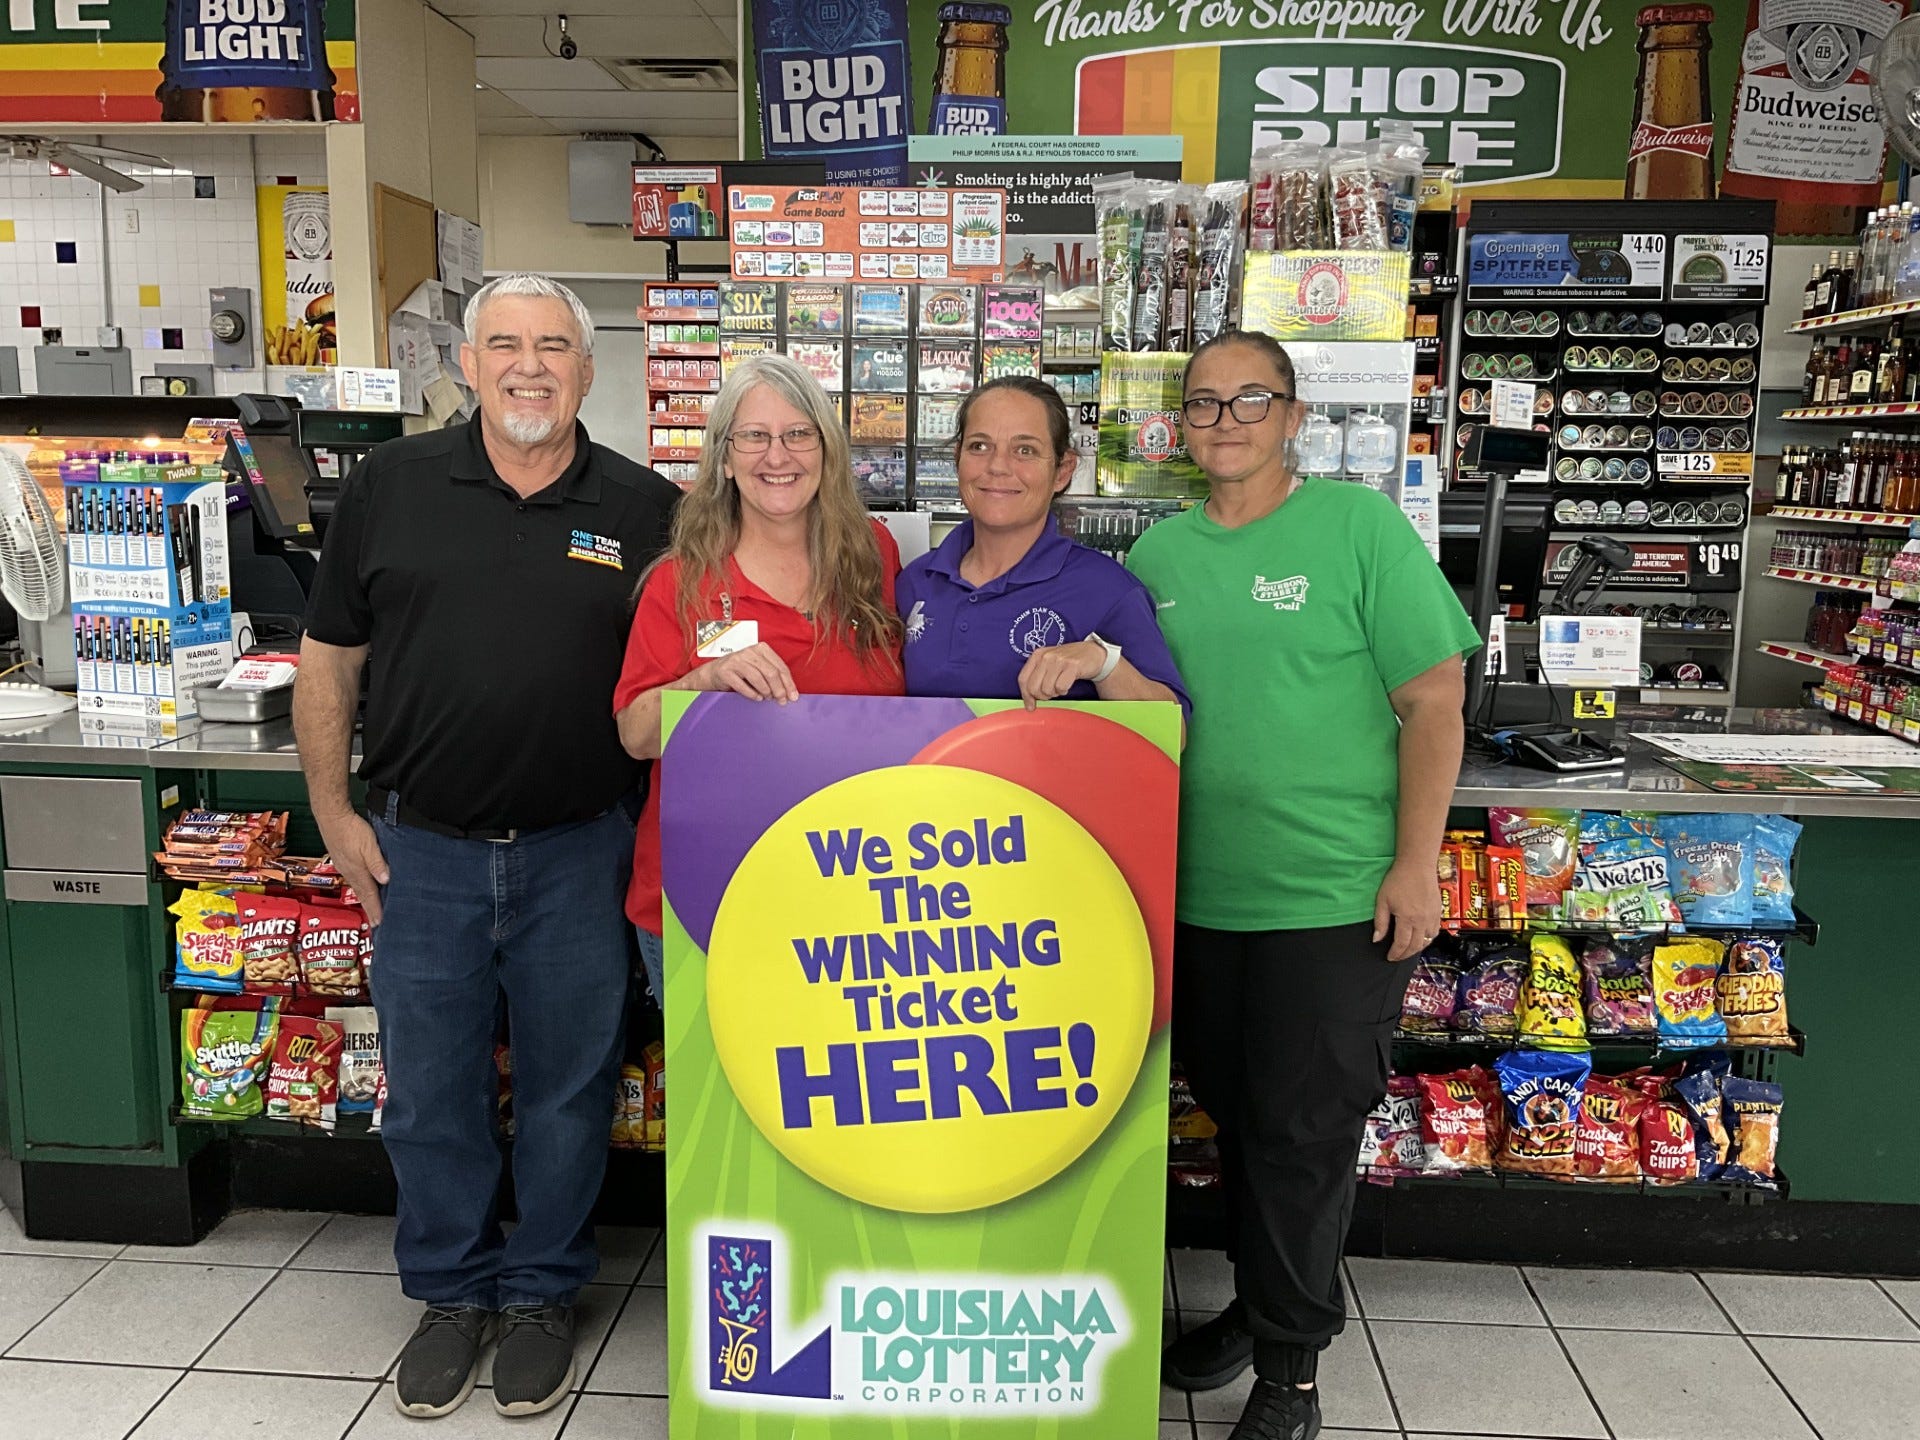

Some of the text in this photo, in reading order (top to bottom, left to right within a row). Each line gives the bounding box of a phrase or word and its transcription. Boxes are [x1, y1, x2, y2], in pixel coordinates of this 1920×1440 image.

[199, 0, 287, 25] BUD
[1034, 0, 1612, 50] Thanks For Shopping With Us
[184, 27, 302, 61] LIGHT
[781, 55, 887, 101] BUD
[1254, 66, 1526, 113] SHOP
[769, 95, 902, 144] LIGHT
[946, 107, 990, 126] BUD
[1632, 129, 1712, 150] Budweiser
[834, 168, 871, 179] USING THE
[955, 173, 1070, 188] Smoking is highly
[798, 190, 818, 201] Fast
[1014, 192, 1048, 205] is the
[784, 208, 845, 217] Game Board
[921, 232, 946, 243] Clue
[1484, 239, 1560, 259] Copenhagen
[1473, 260, 1572, 271] SPITFREE
[898, 287, 903, 295] 3
[966, 289, 971, 297] 2
[733, 292, 764, 314] SIX
[928, 301, 967, 313] CASINO
[724, 315, 773, 330] FIGURES
[764, 341, 773, 349] 10
[832, 343, 838, 351] 9
[873, 351, 903, 363] Clue
[922, 351, 970, 366] BLACKJACK
[1111, 369, 1168, 381] PERFUME
[1295, 373, 1409, 383] ACCESSORIES
[894, 397, 903, 405] 13
[1660, 455, 1678, 463] SAVE
[166, 466, 196, 481] TWANG
[571, 530, 621, 549] ONE TEAM
[571, 538, 622, 559] ONE GOAL
[571, 547, 622, 565] SHOP RITE
[1258, 578, 1303, 592] BOURBON
[1260, 586, 1298, 598] STREET
[1273, 602, 1300, 611] Deli
[1014, 610, 1031, 624] JOHN
[186, 648, 221, 660] WARNING:
[200, 658, 222, 669] product
[178, 672, 205, 681] contains
[806, 815, 1026, 878] We Sold
[1674, 844, 1708, 859] Freeze
[1711, 841, 1742, 853] Dried
[1688, 851, 1728, 864] Candy
[1507, 857, 1522, 901] Reese's
[1593, 860, 1665, 887] Welch's
[53, 880, 101, 894] WASTE
[868, 876, 971, 924] The
[242, 919, 296, 939] GIANTS
[183, 932, 245, 953] Swedish
[302, 930, 359, 949] GIANTS
[194, 950, 234, 966] Fish
[308, 949, 355, 960] CASHEWS
[792, 919, 1061, 984] WINNING
[1600, 975, 1644, 990] SOUR
[1718, 975, 1783, 994] CHEDDAR
[1601, 988, 1649, 1001] PATCH
[843, 975, 1018, 1032] Ticket
[1723, 993, 1777, 1015] FRIES
[196, 1042, 261, 1065] Skittles
[288, 1036, 318, 1059] RITZ
[271, 1062, 309, 1083] Toasted
[775, 1022, 1099, 1130] HERE!
[269, 1080, 289, 1094] CHIPS
[1508, 1077, 1539, 1105] ANDY
[1584, 1095, 1621, 1122] RITZ
[1432, 1119, 1469, 1134] CHIPS
[1510, 1136, 1575, 1155] FRIES
[1650, 1154, 1687, 1169] CHIPS
[841, 1285, 1117, 1335] LOUISIANA
[862, 1335, 1096, 1384] LOTTERY
[862, 1386, 1084, 1402] CORPORATION
